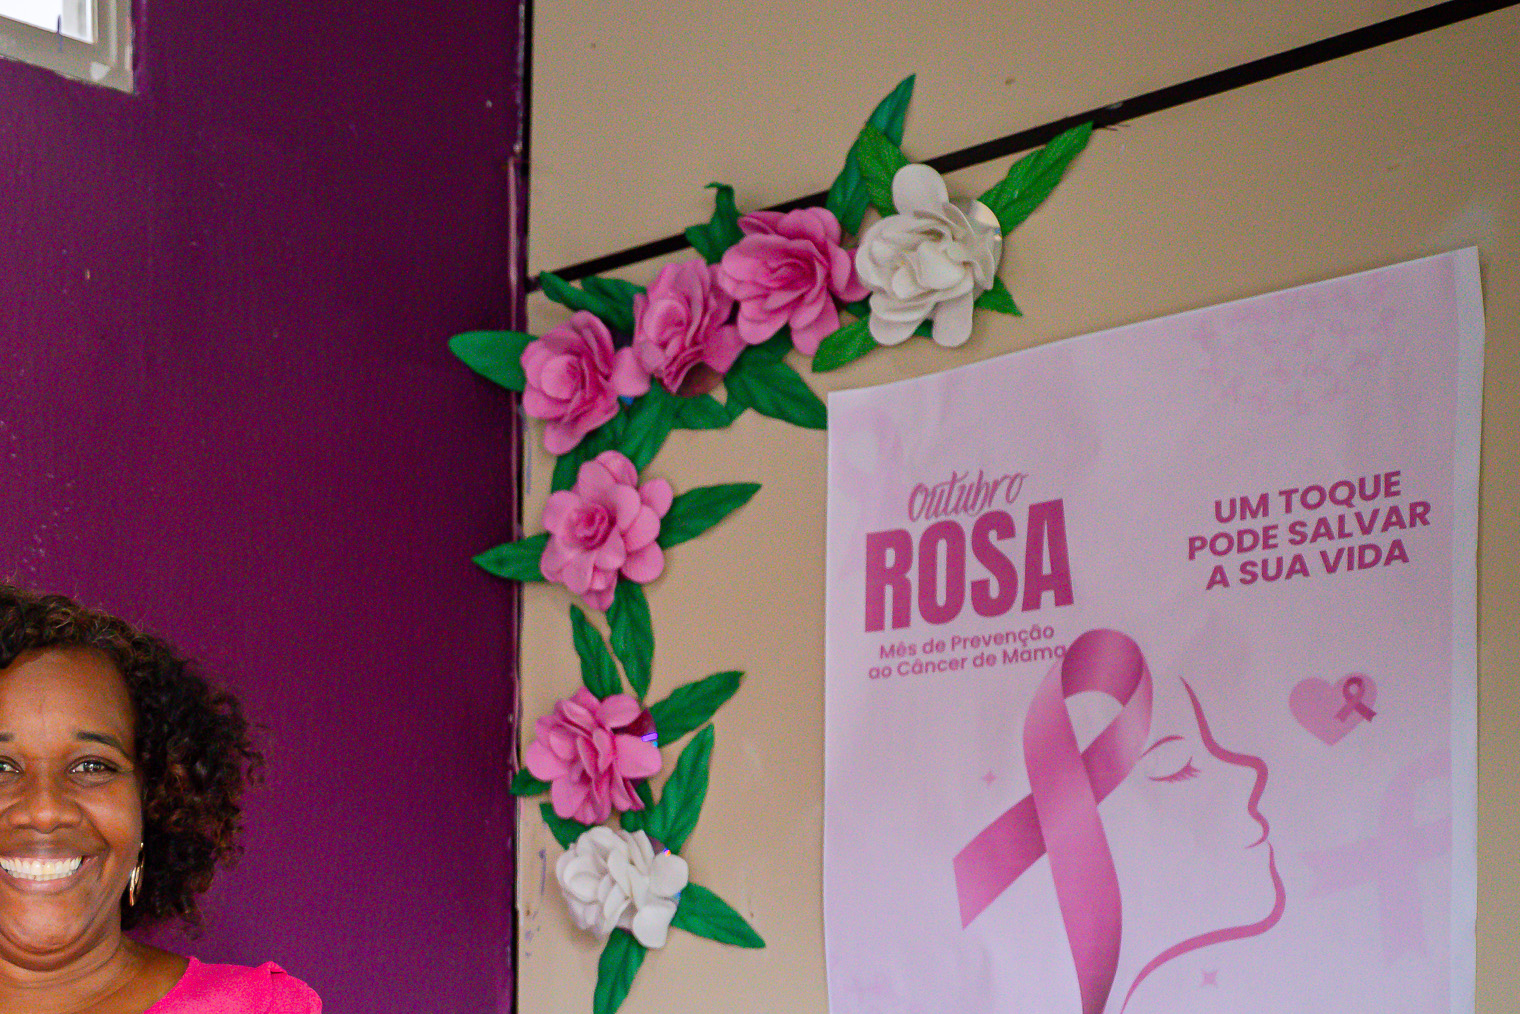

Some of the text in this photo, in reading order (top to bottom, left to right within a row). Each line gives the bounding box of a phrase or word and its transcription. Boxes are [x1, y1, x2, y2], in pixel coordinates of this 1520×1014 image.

[908, 469, 1029, 522] Outubro
[1214, 470, 1401, 523] UM TOQUE
[1188, 501, 1431, 561] PODE SALVAR
[865, 498, 1074, 632] ROSA
[1206, 539, 1409, 590] A SUA VIDA
[869, 644, 1067, 680] ao Câncer de Mama
[880, 624, 1055, 659] Mês de Prevenção
